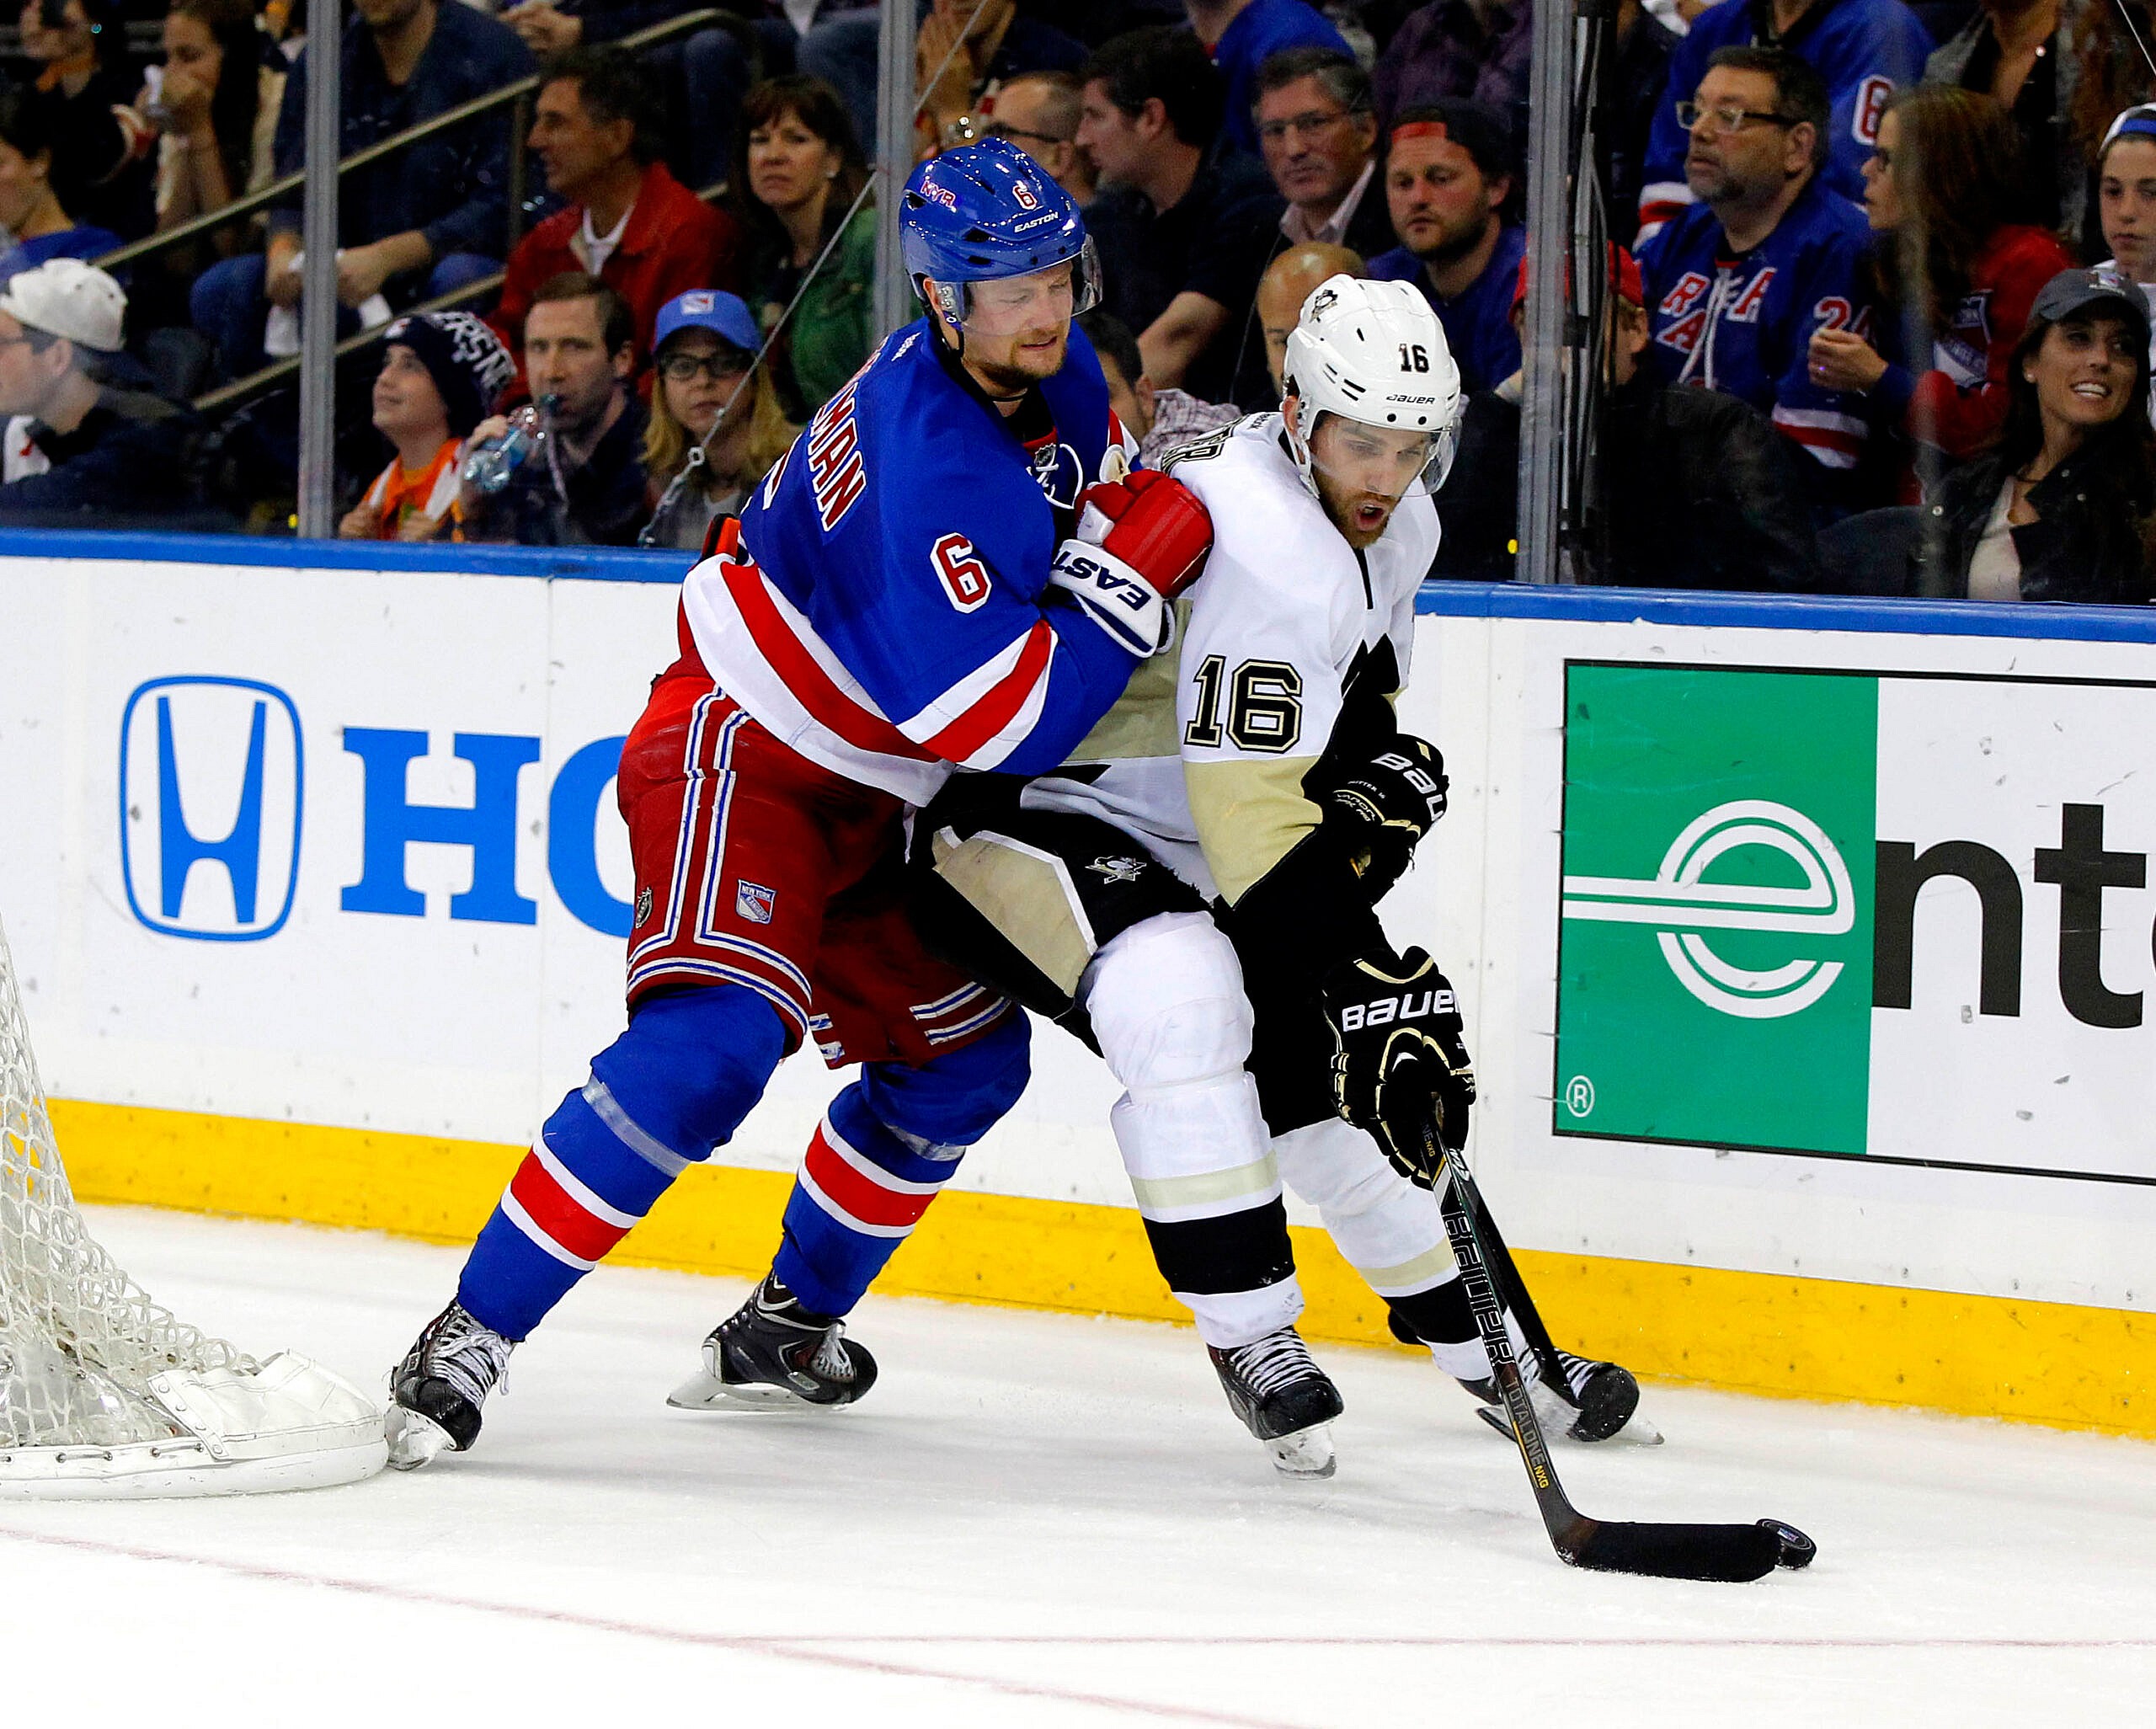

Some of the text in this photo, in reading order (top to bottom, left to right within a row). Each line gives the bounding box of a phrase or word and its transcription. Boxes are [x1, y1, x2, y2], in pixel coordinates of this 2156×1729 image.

[920, 179, 956, 209] NYR
[1012, 179, 1038, 210] 6
[1014, 211, 1059, 233] EASTON
[1398, 343, 1430, 373] 16
[930, 532, 991, 613] 6
[1183, 654, 1303, 753] 16
[1562, 799, 2156, 1030] ent
[1534, 1465, 1550, 1489] NXG
